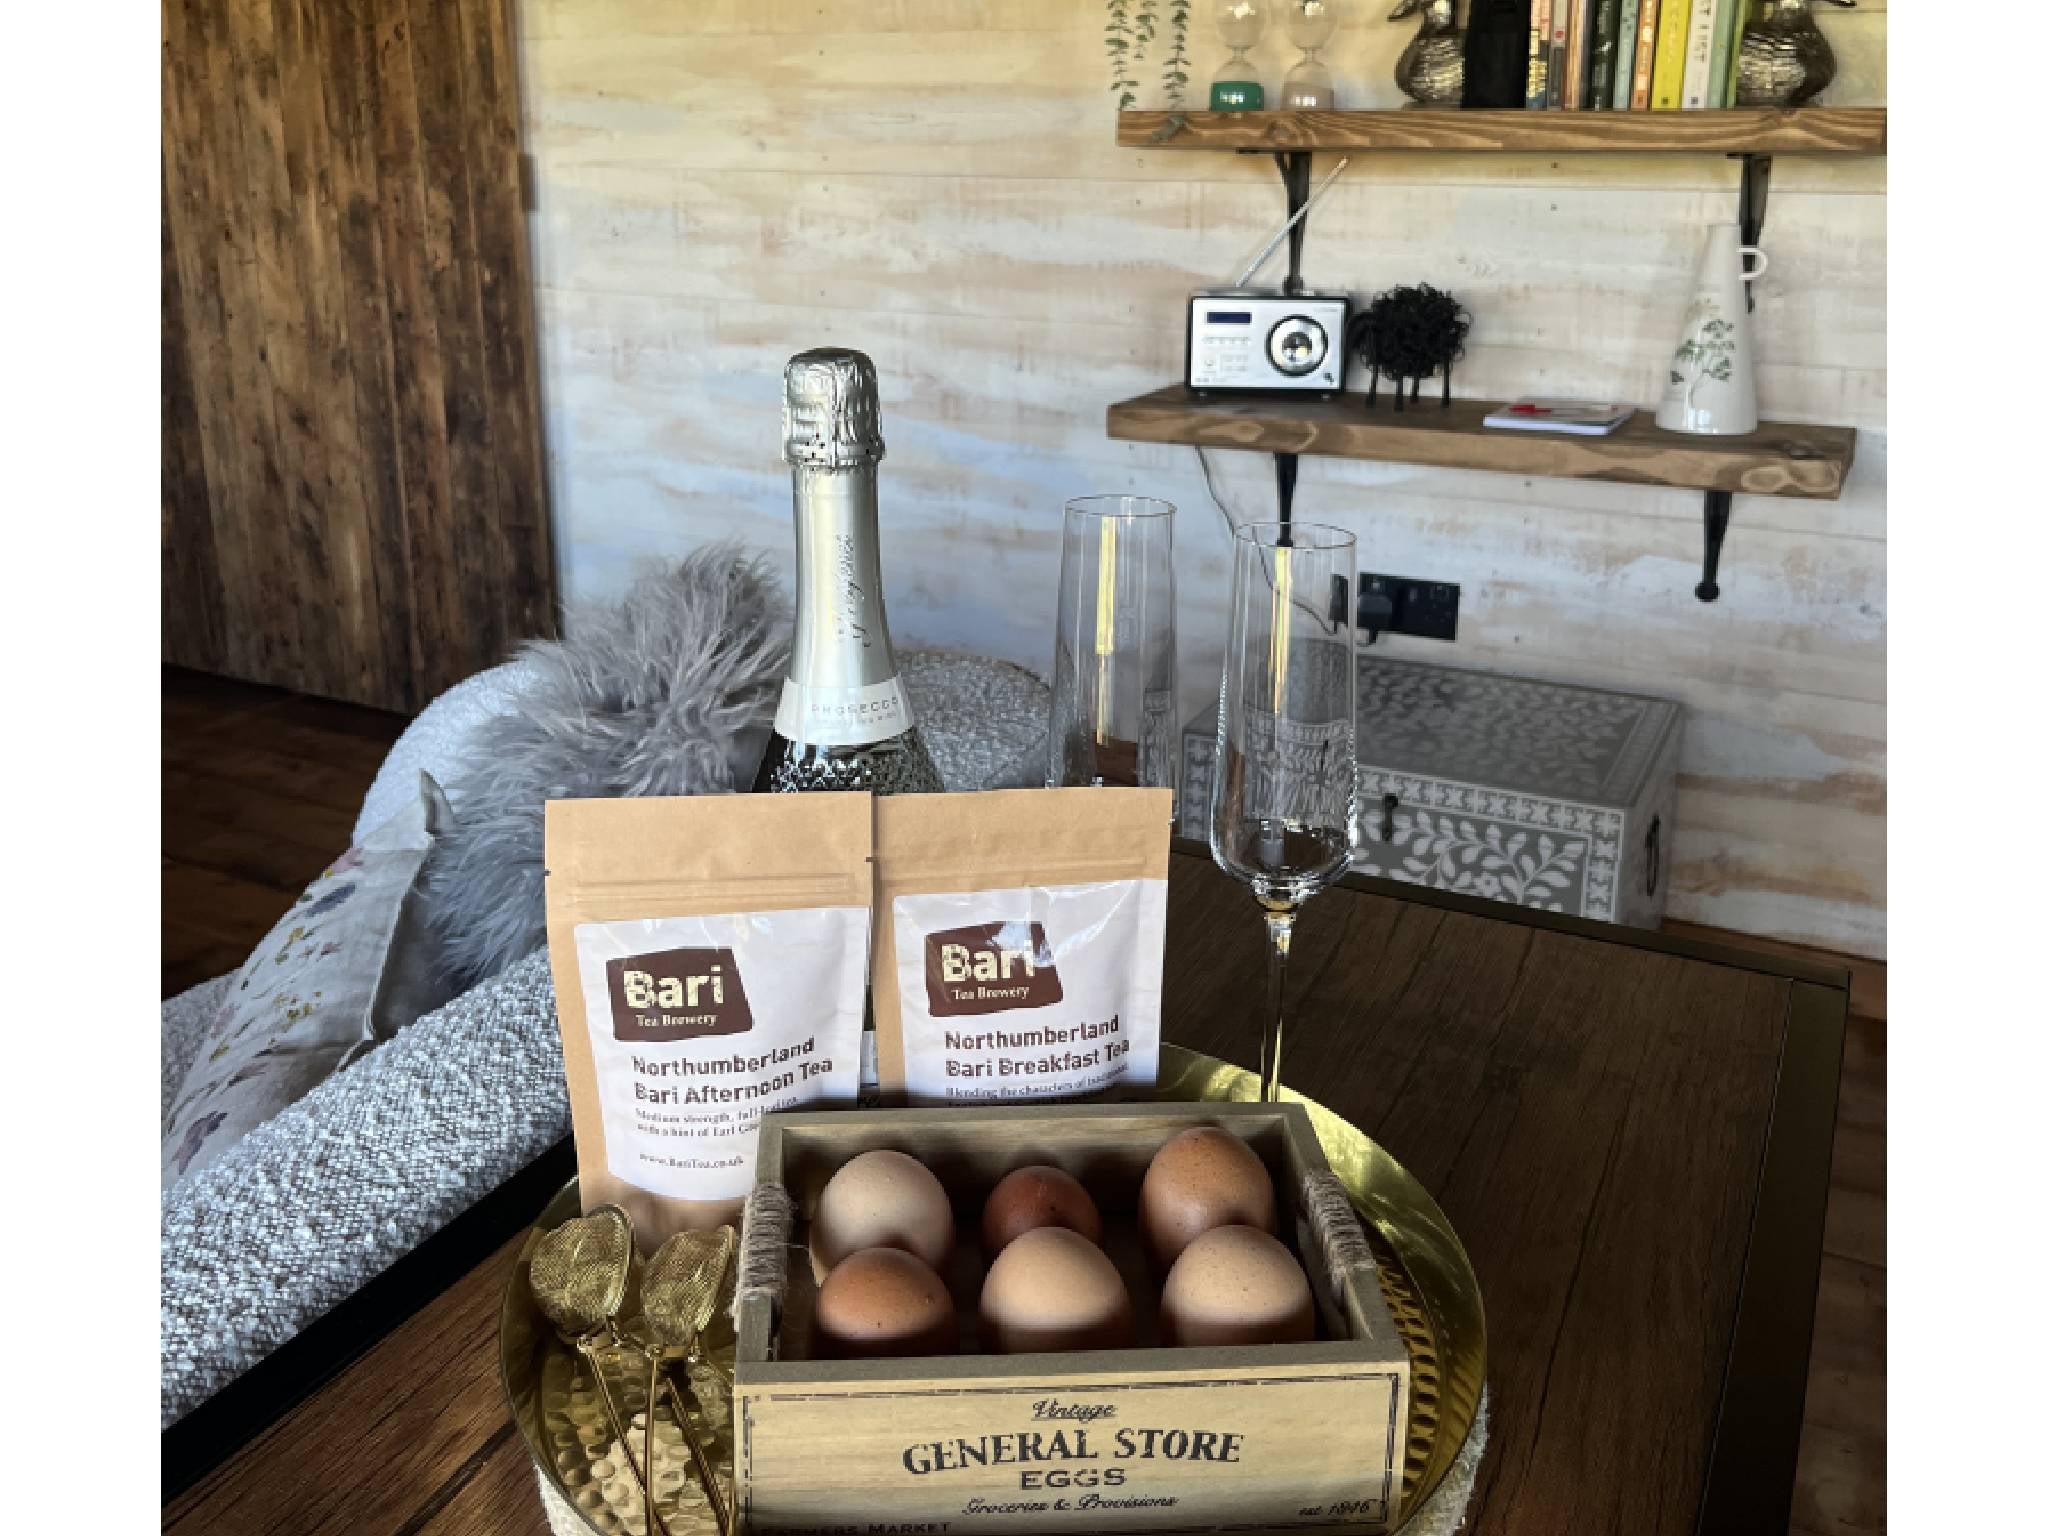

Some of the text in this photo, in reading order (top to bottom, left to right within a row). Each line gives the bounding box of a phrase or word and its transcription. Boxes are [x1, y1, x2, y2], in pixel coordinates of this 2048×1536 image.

[940, 939, 1036, 982] Bari
[623, 964, 724, 1008] Bari
[950, 985, 1030, 1000] Tea Brewery
[635, 1014, 718, 1027] Tea Brewery
[944, 1014, 1119, 1050] Northumberland
[631, 1035, 816, 1077] Northumberland
[945, 1058, 993, 1077] Bari
[998, 1049, 1100, 1076] Breakfast
[1103, 1039, 1130, 1062] Tea
[634, 1057, 833, 1105] Bari Afternoon Tea
[635, 1106, 680, 1124] Medium
[713, 1121, 735, 1137] Earl
[1031, 1398, 1118, 1424] Vintage
[903, 1427, 1245, 1475] GENERAL STORE
[1019, 1467, 1127, 1491] EGGS
[961, 1493, 1179, 1516] Groceries & Provisions
[866, 1523, 952, 1535] MARKET
